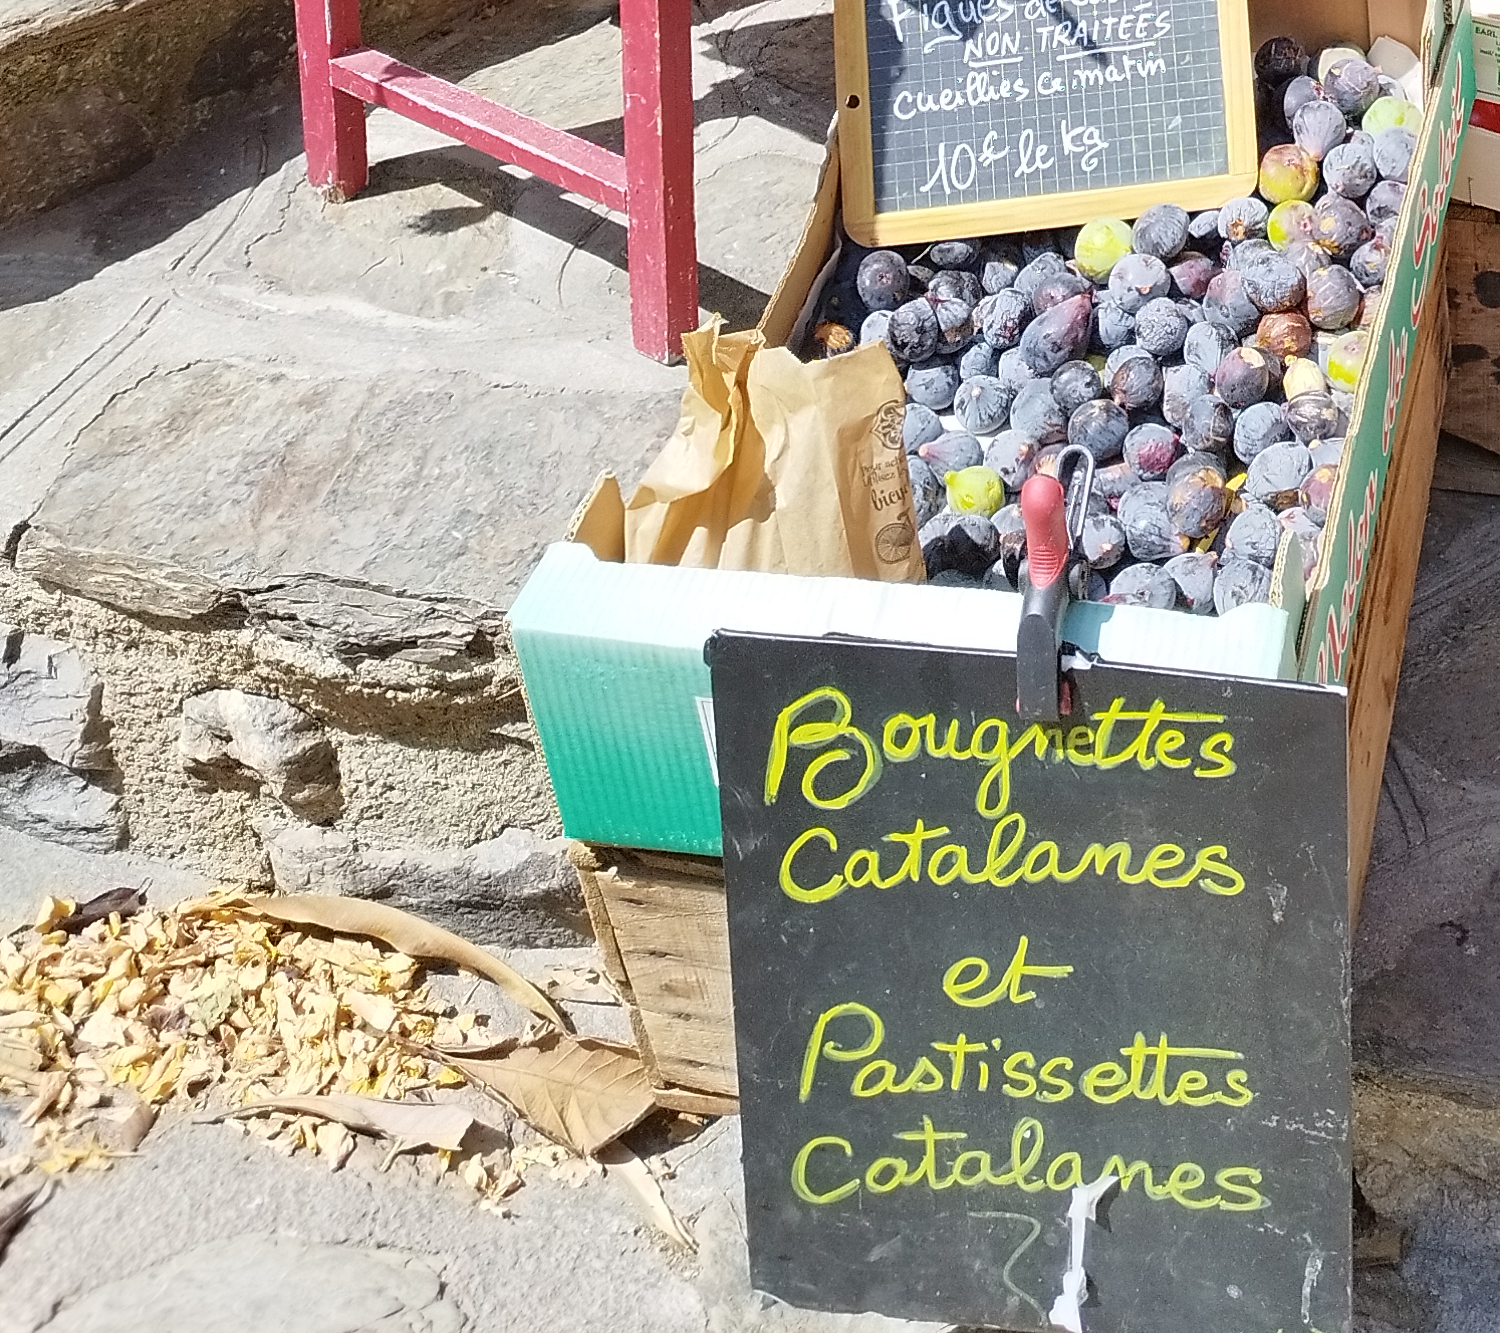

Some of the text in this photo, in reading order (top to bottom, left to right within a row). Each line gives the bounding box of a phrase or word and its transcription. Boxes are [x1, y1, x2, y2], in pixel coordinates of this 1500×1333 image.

[963, 32, 1021, 64] NON
[1072, 55, 1167, 90] matin
[1014, 128, 1055, 178] le
[1410, 51, 1466, 331] Soleil
[763, 685, 1237, 819] Bougnettes
[778, 811, 1246, 905] Catalanes
[942, 934, 1074, 1008] et
[799, 1002, 1256, 1109] Pastissettes
[790, 1114, 1273, 1215] Catalanes
